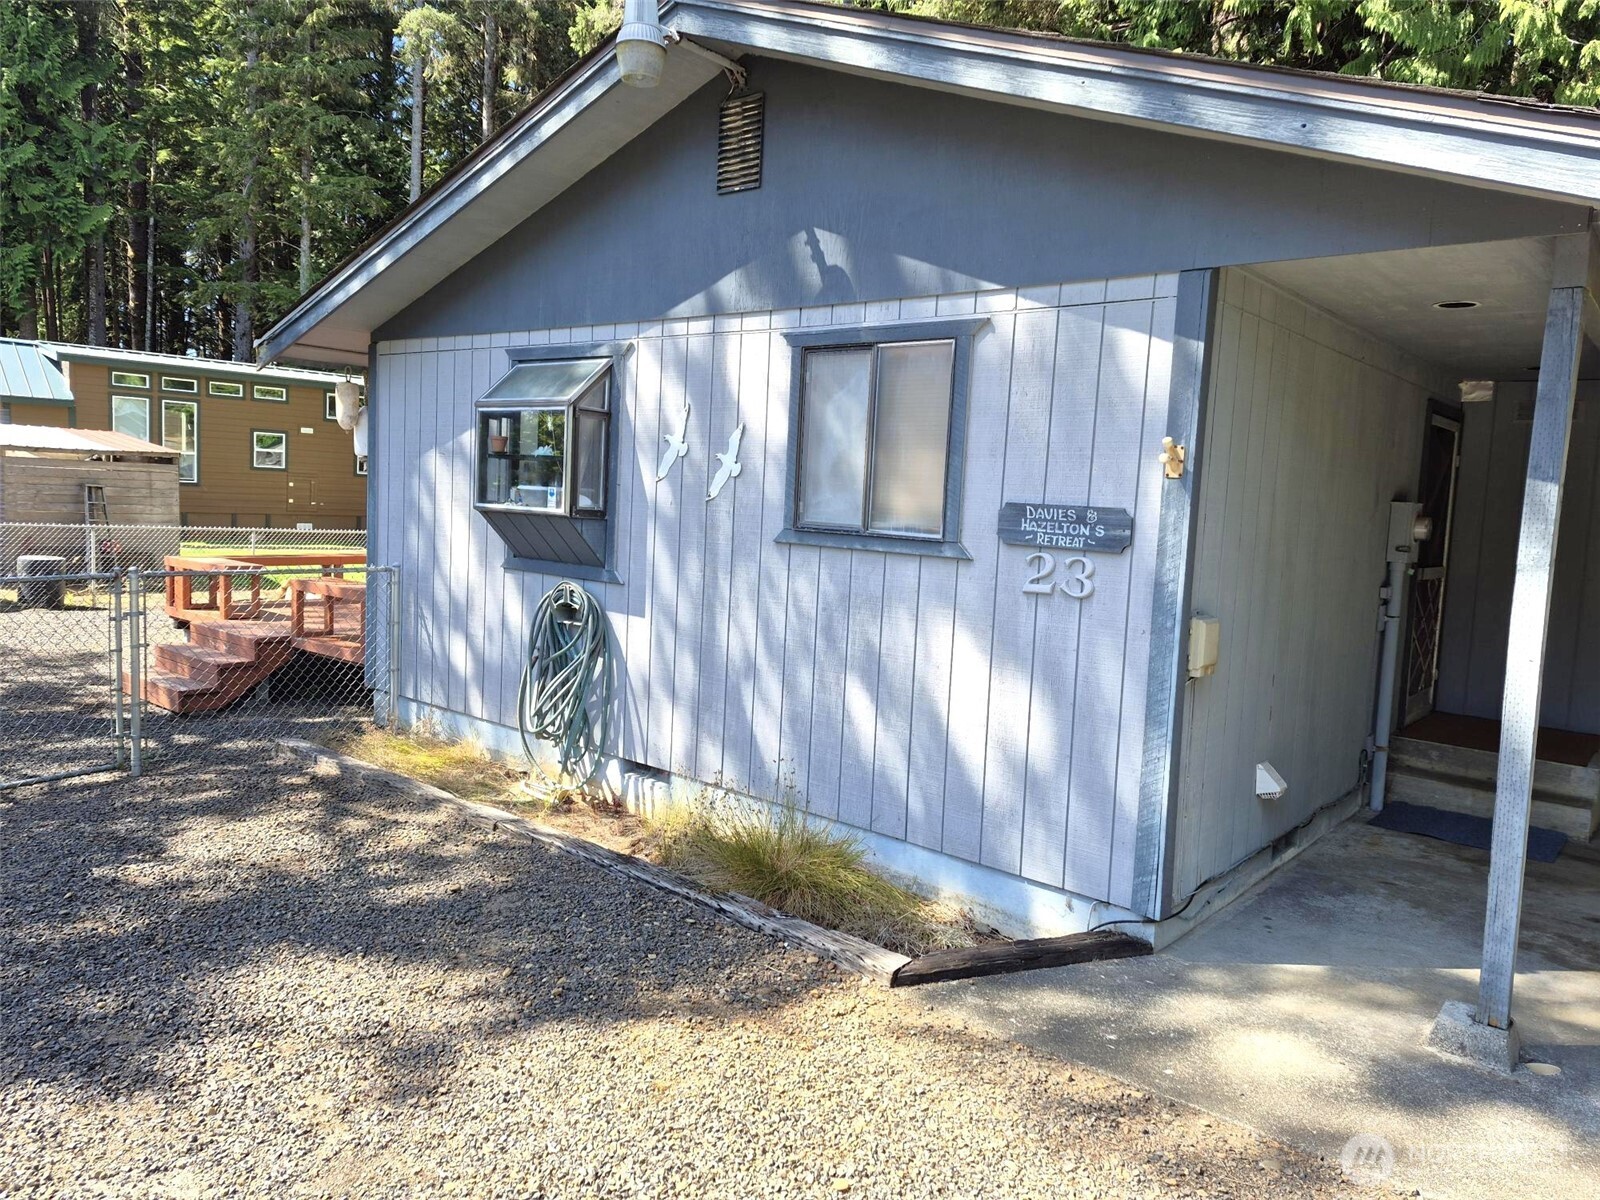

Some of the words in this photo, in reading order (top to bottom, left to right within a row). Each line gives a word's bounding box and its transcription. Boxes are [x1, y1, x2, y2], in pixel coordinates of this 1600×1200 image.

[1026, 505, 1076, 521] DAVIES
[1087, 509, 1098, 523] &
[1036, 533, 1085, 547] RETREAT
[1022, 552, 1096, 599] 23
